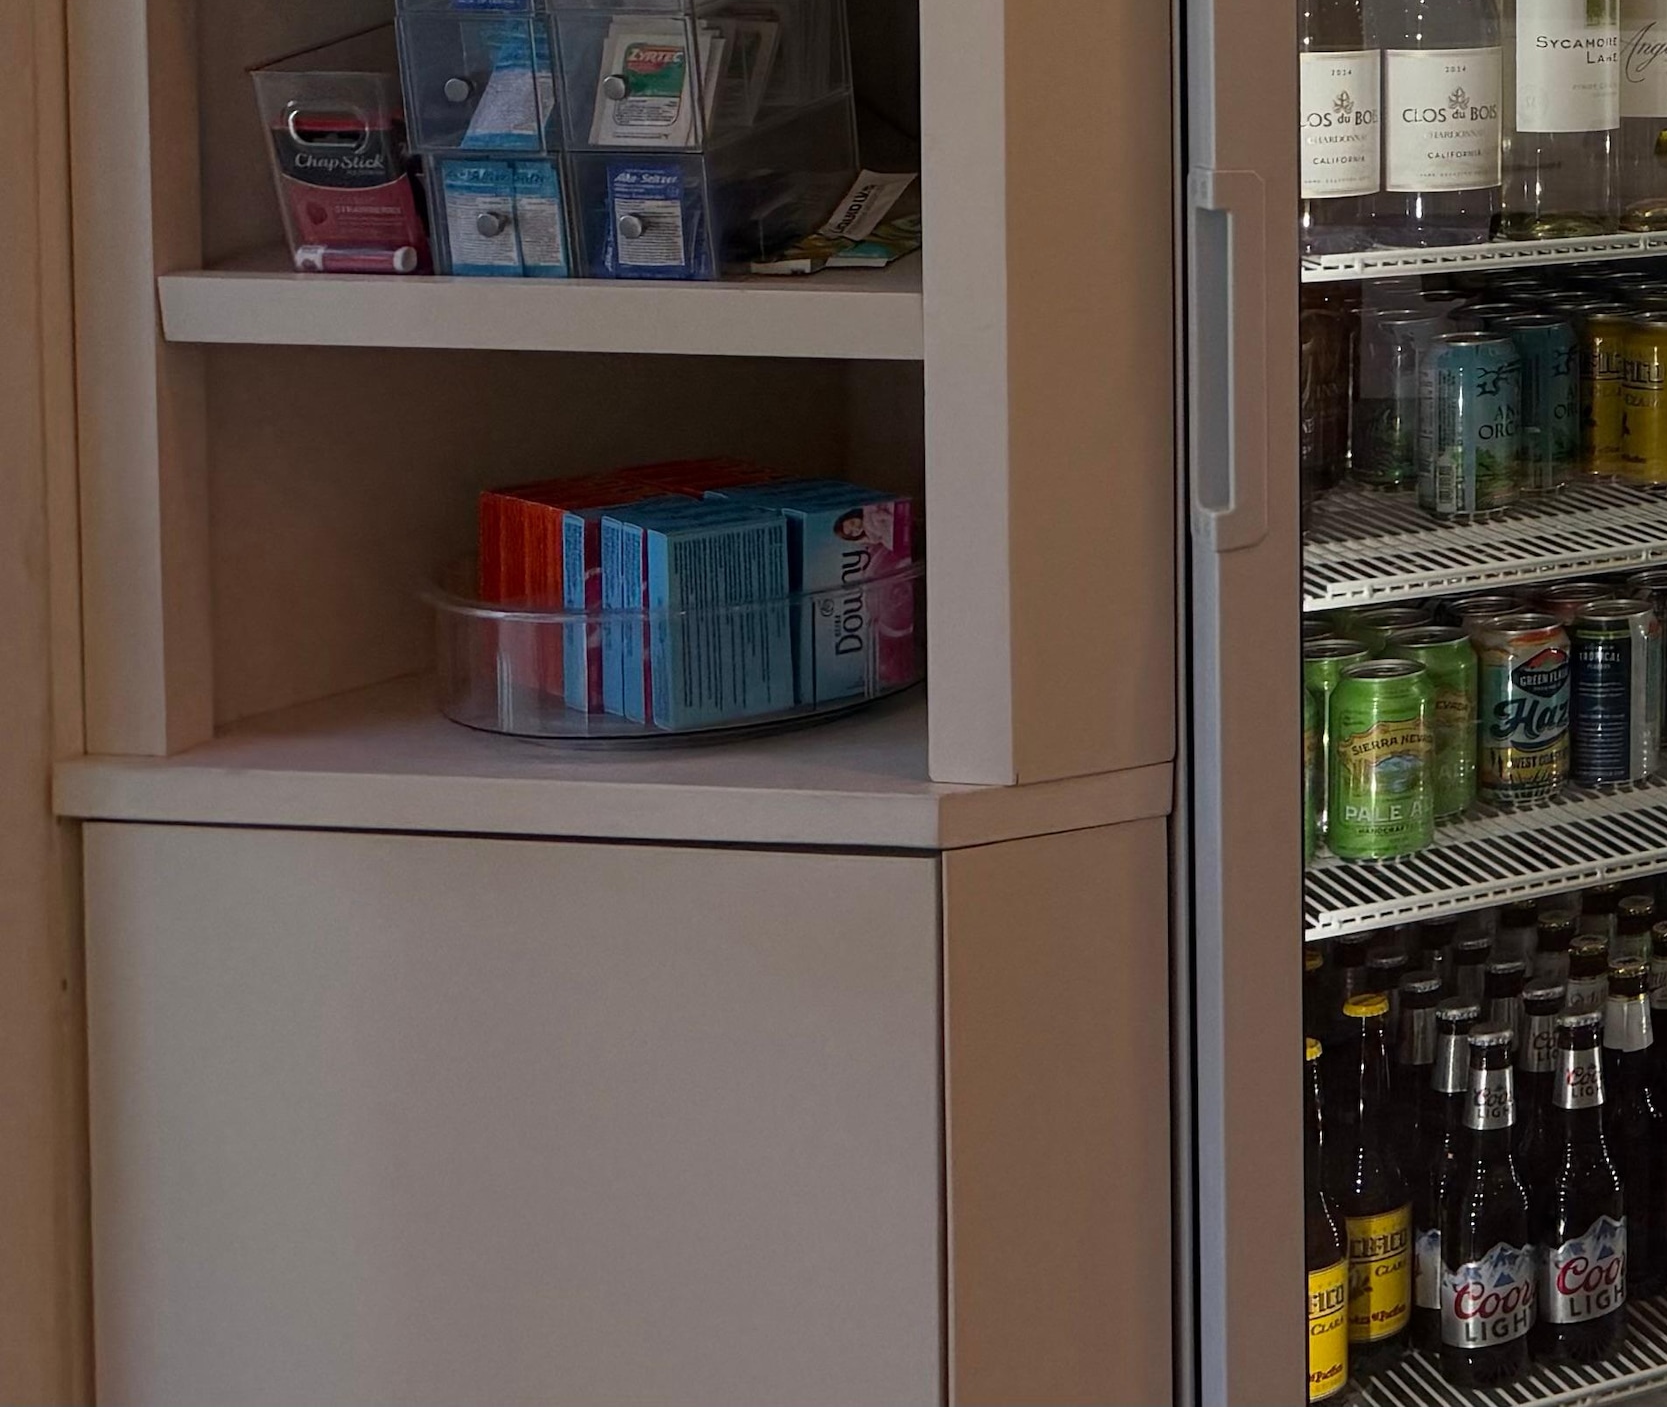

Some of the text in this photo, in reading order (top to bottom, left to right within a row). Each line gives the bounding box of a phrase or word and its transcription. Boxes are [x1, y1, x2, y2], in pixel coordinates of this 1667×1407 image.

[627, 47, 684, 64] ZYRTEC
[1337, 114, 1351, 124] du
[1402, 104, 1497, 123] CLOS du BOIS
[1519, 671, 1549, 686] GREEN
[1490, 697, 1570, 741] Haz
[1352, 736, 1398, 756] SIERRA
[1345, 805, 1403, 822] PALE
[1453, 1280, 1535, 1321] Coor
[1465, 1305, 1531, 1343] LIGH
